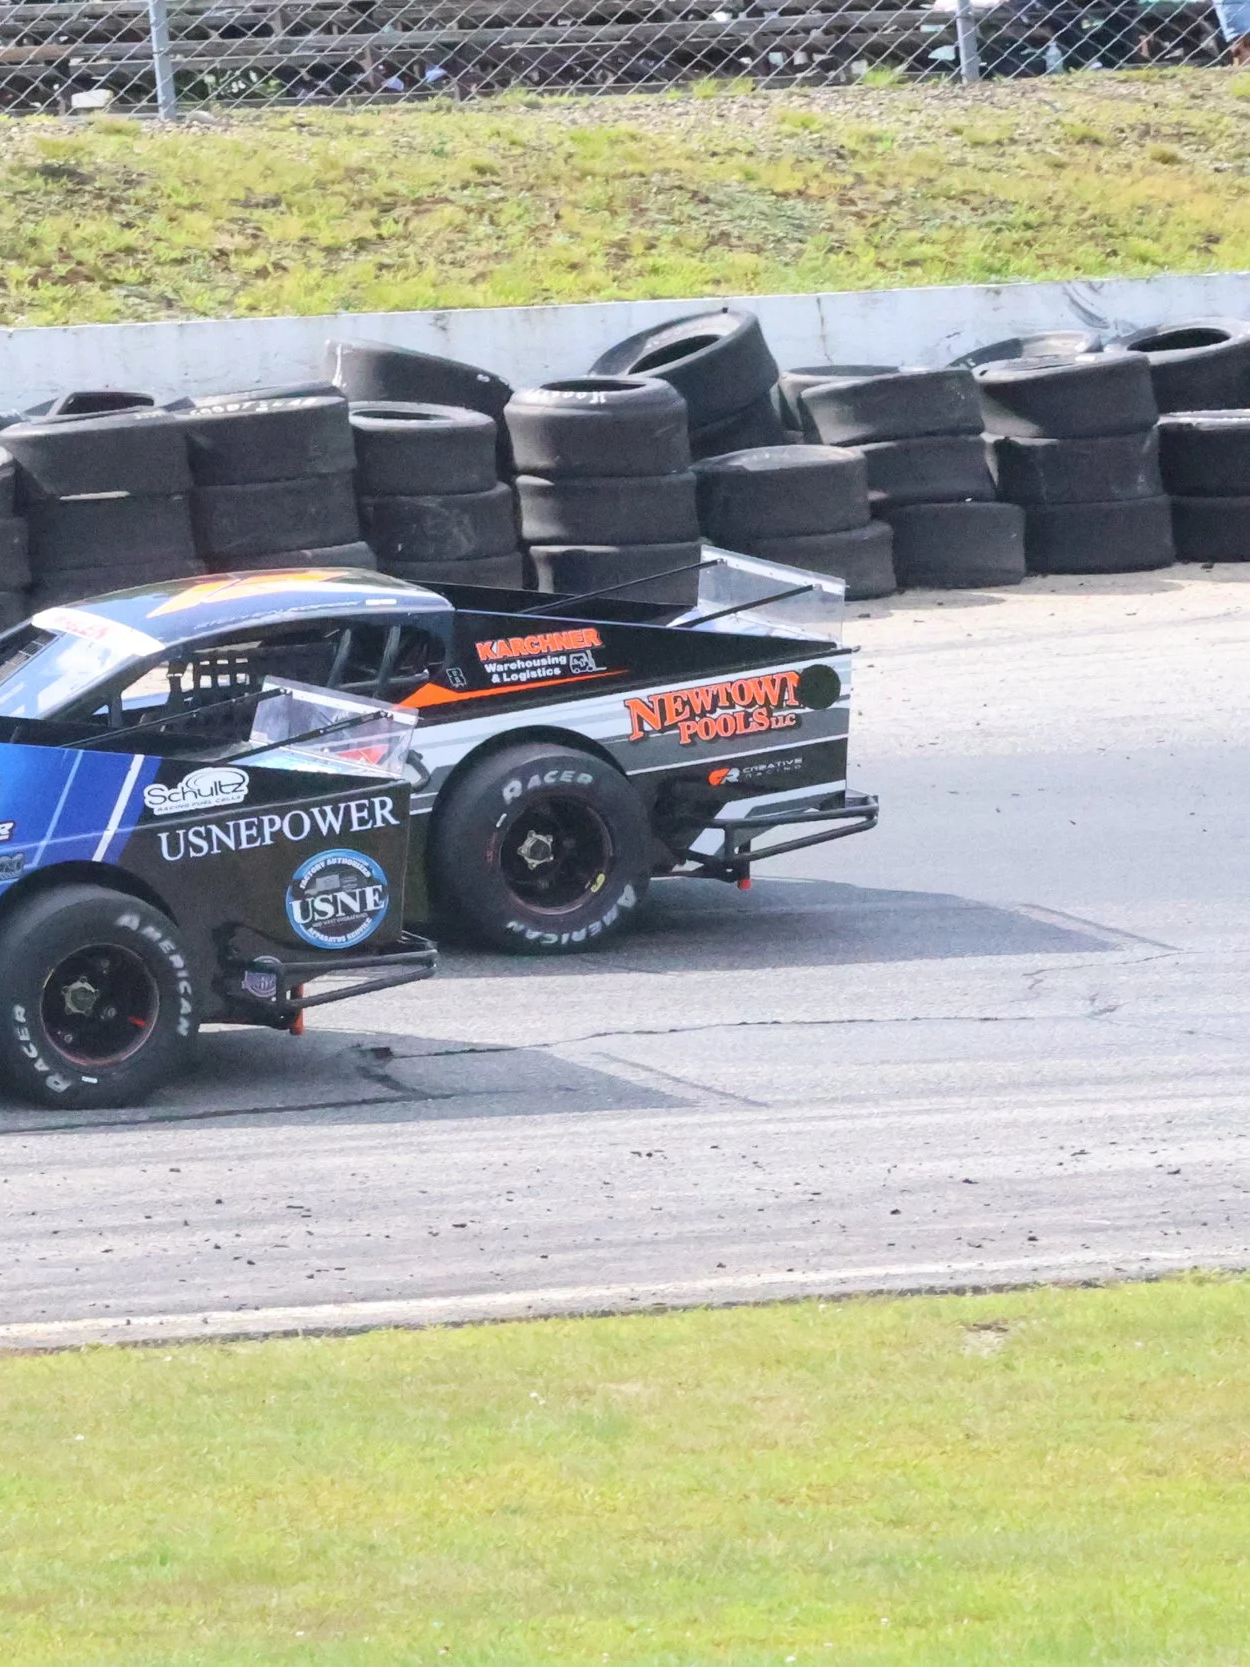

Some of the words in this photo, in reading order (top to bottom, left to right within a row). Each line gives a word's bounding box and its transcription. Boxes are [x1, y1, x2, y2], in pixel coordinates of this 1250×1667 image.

[475, 627, 602, 661] KARCHNER
[484, 654, 567, 674] Warehousing
[491, 675, 499, 684] &
[503, 666, 561, 683] Logistics
[679, 706, 769, 745] POOLS
[770, 713, 797, 729] LLC
[146, 770, 246, 807] Schultz
[502, 769, 594, 806] RACER
[157, 795, 401, 862] USNEPOWER
[299, 860, 326, 890] FACTORY
[326, 856, 372, 878] AUTHORIZED
[289, 884, 385, 924] USNE
[506, 883, 638, 946] AMERICAN
[307, 926, 347, 943] APPARATUS
[347, 917, 373, 939] SERVICE
[115, 913, 192, 1037] AMERICAN
[13, 1004, 73, 1094] RACER
